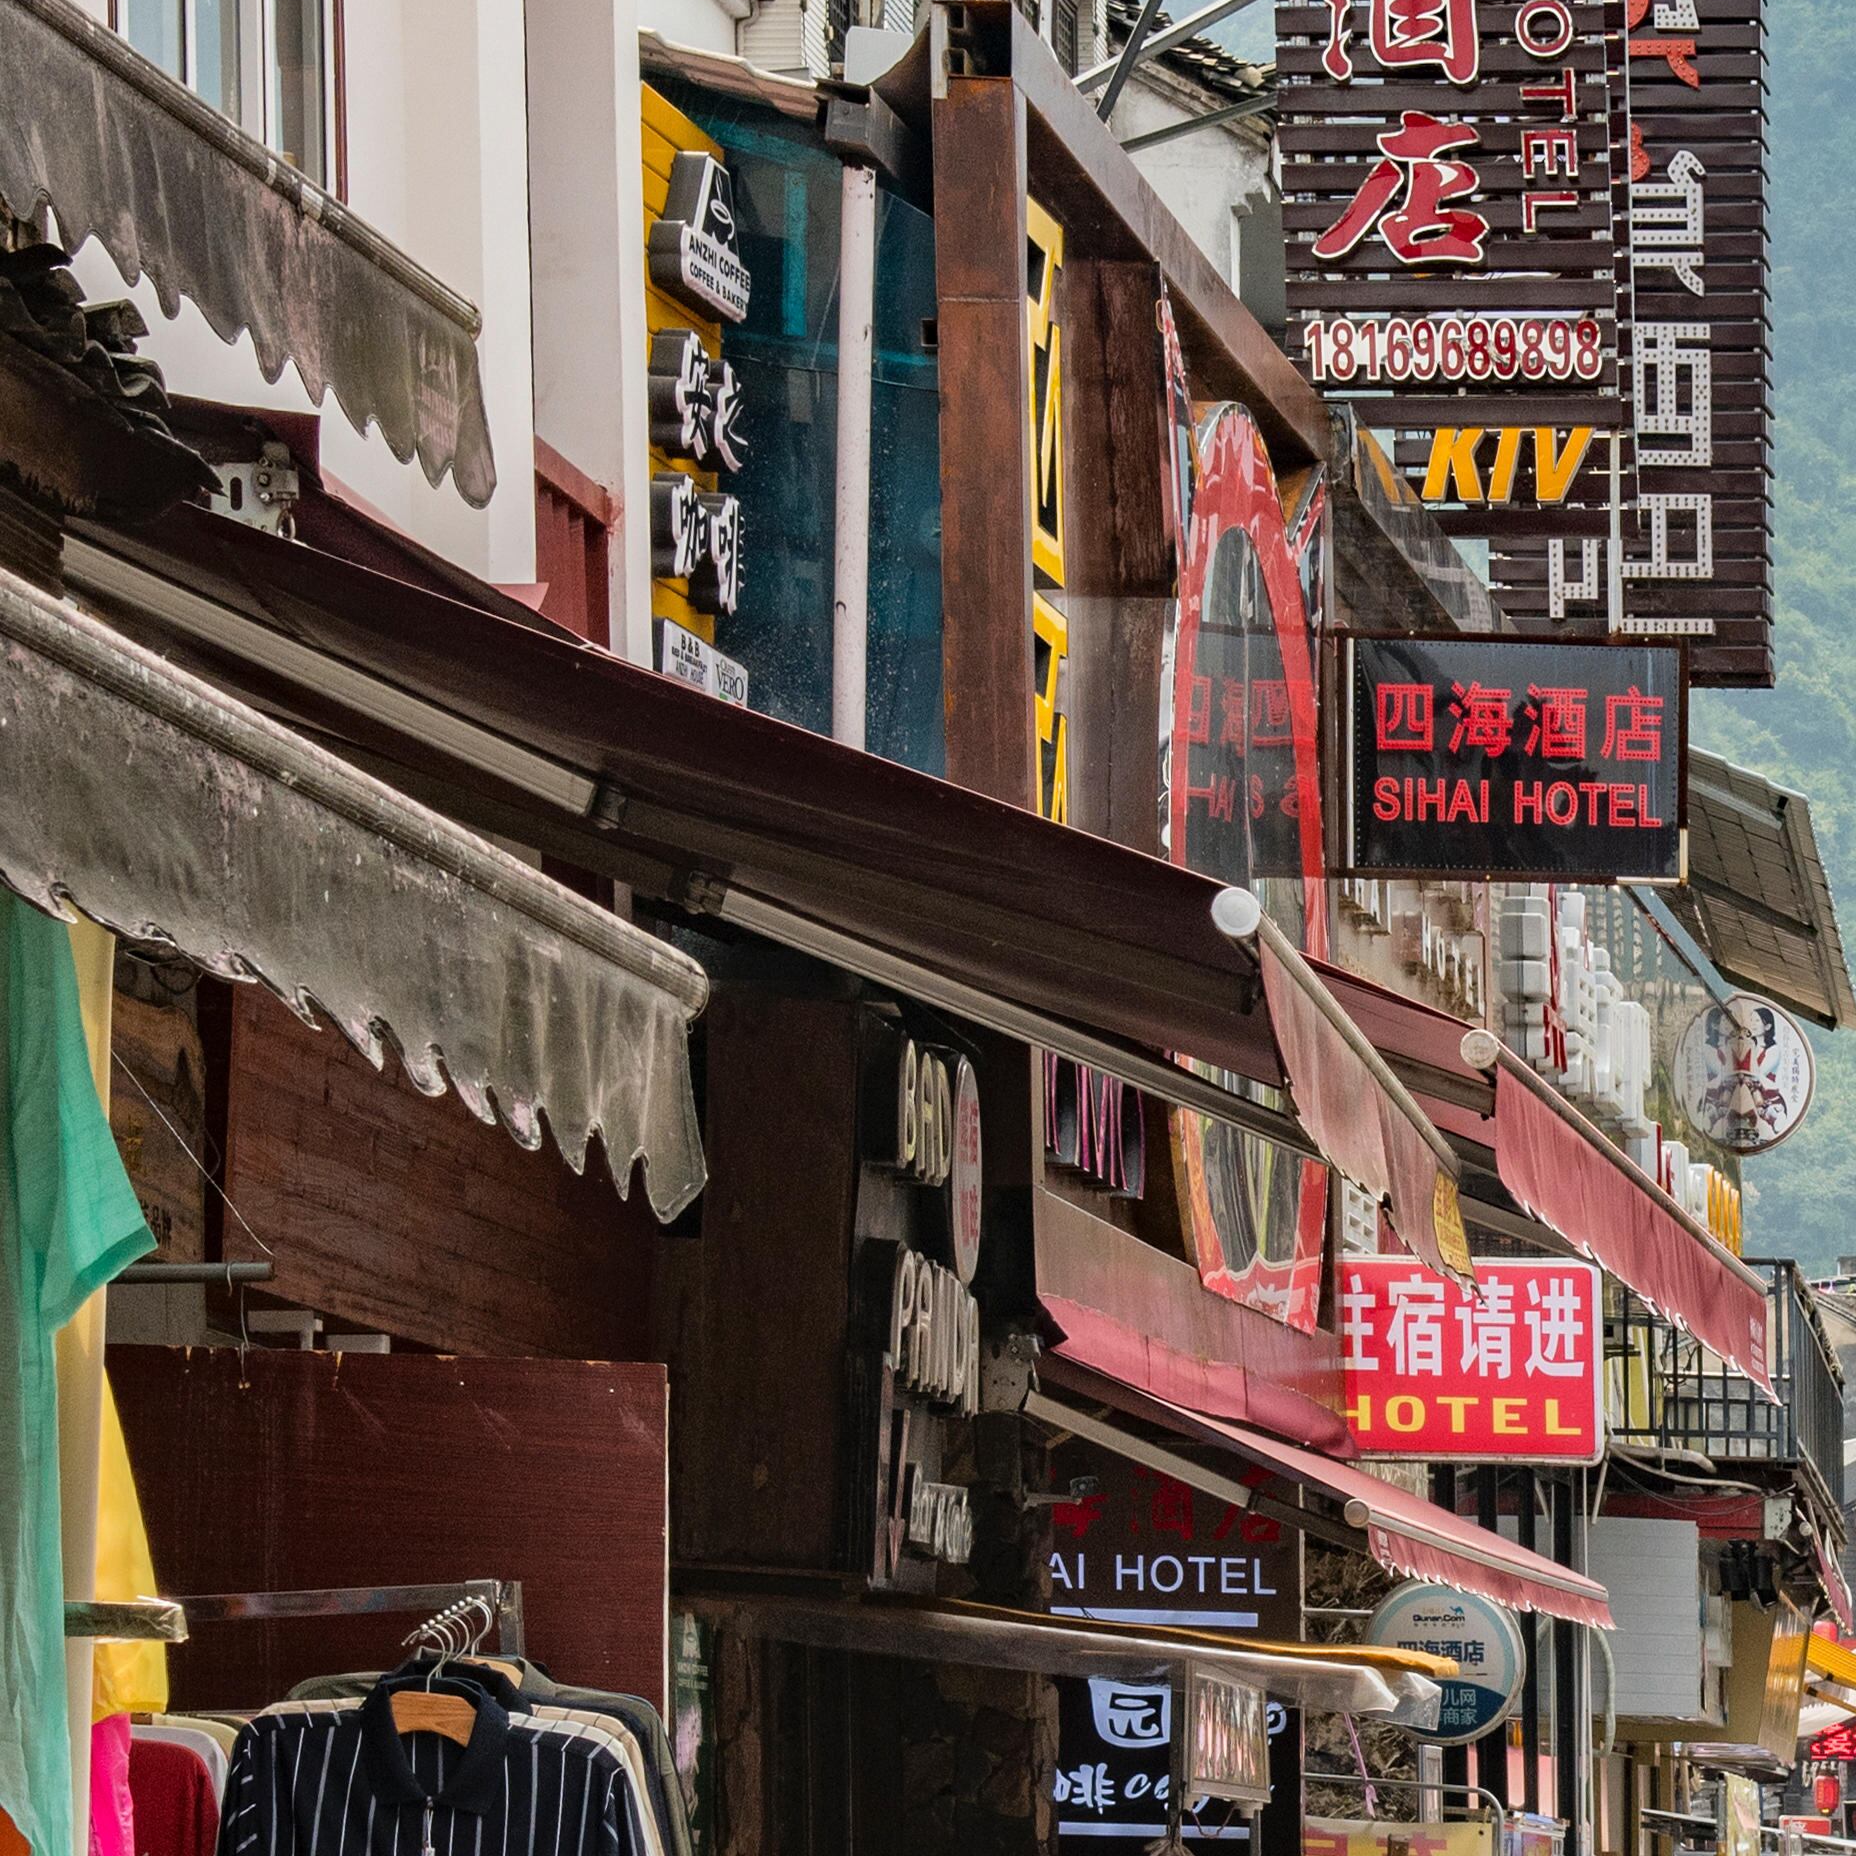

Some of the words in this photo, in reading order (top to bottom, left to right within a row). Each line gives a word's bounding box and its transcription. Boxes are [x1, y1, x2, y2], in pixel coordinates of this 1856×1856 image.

[688, 233, 717, 268] ANZHI
[719, 256, 750, 293] COFFEE
[690, 261, 715, 291] COFFEE
[1303, 318, 1604, 382] 18169689898
[715, 663, 745, 701] VERO
[1374, 680, 1665, 763] 四海酒店
[1372, 776, 1490, 824] SIHAI
[1513, 779, 1663, 829] HOTEL
[898, 1037, 953, 1189] BAD
[1114, 1554, 1278, 1597] HOTEL
